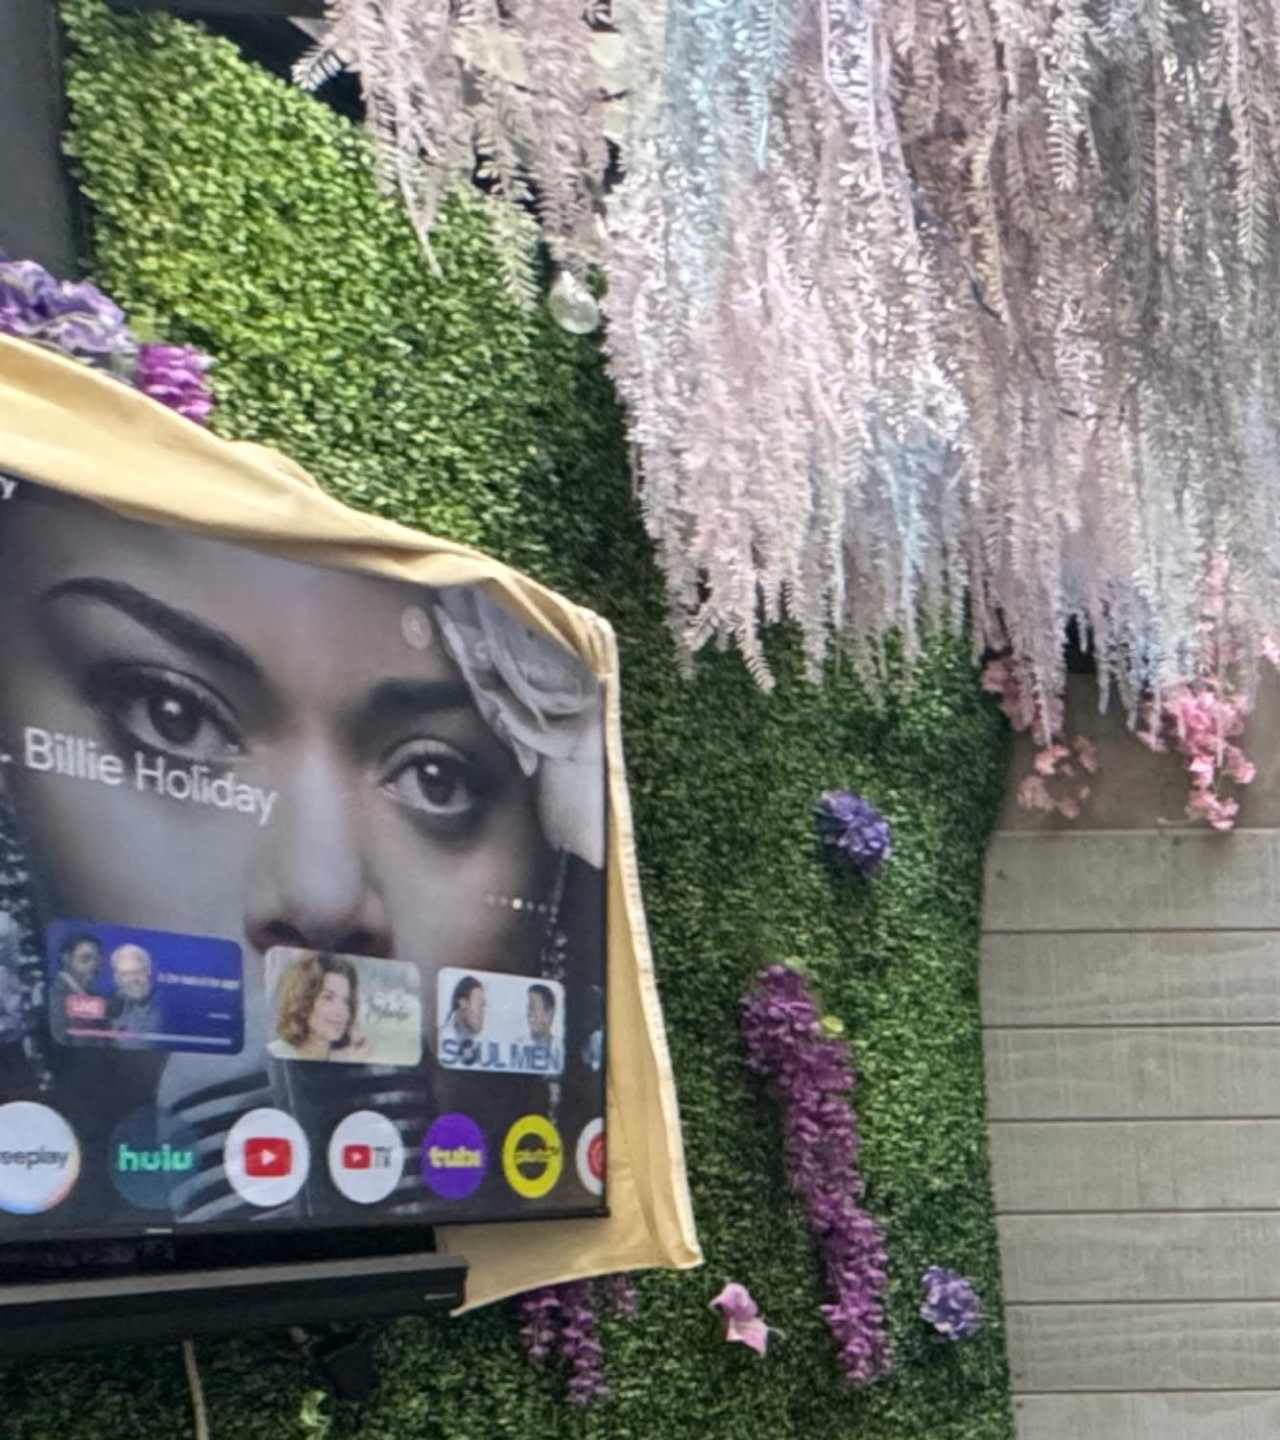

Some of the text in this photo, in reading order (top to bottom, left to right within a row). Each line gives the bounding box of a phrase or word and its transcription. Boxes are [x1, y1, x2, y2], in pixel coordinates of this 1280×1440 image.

[24, 727, 278, 827] Billie Holiday
[509, 1042, 562, 1071] MEN
[118, 1143, 193, 1171] hulu
